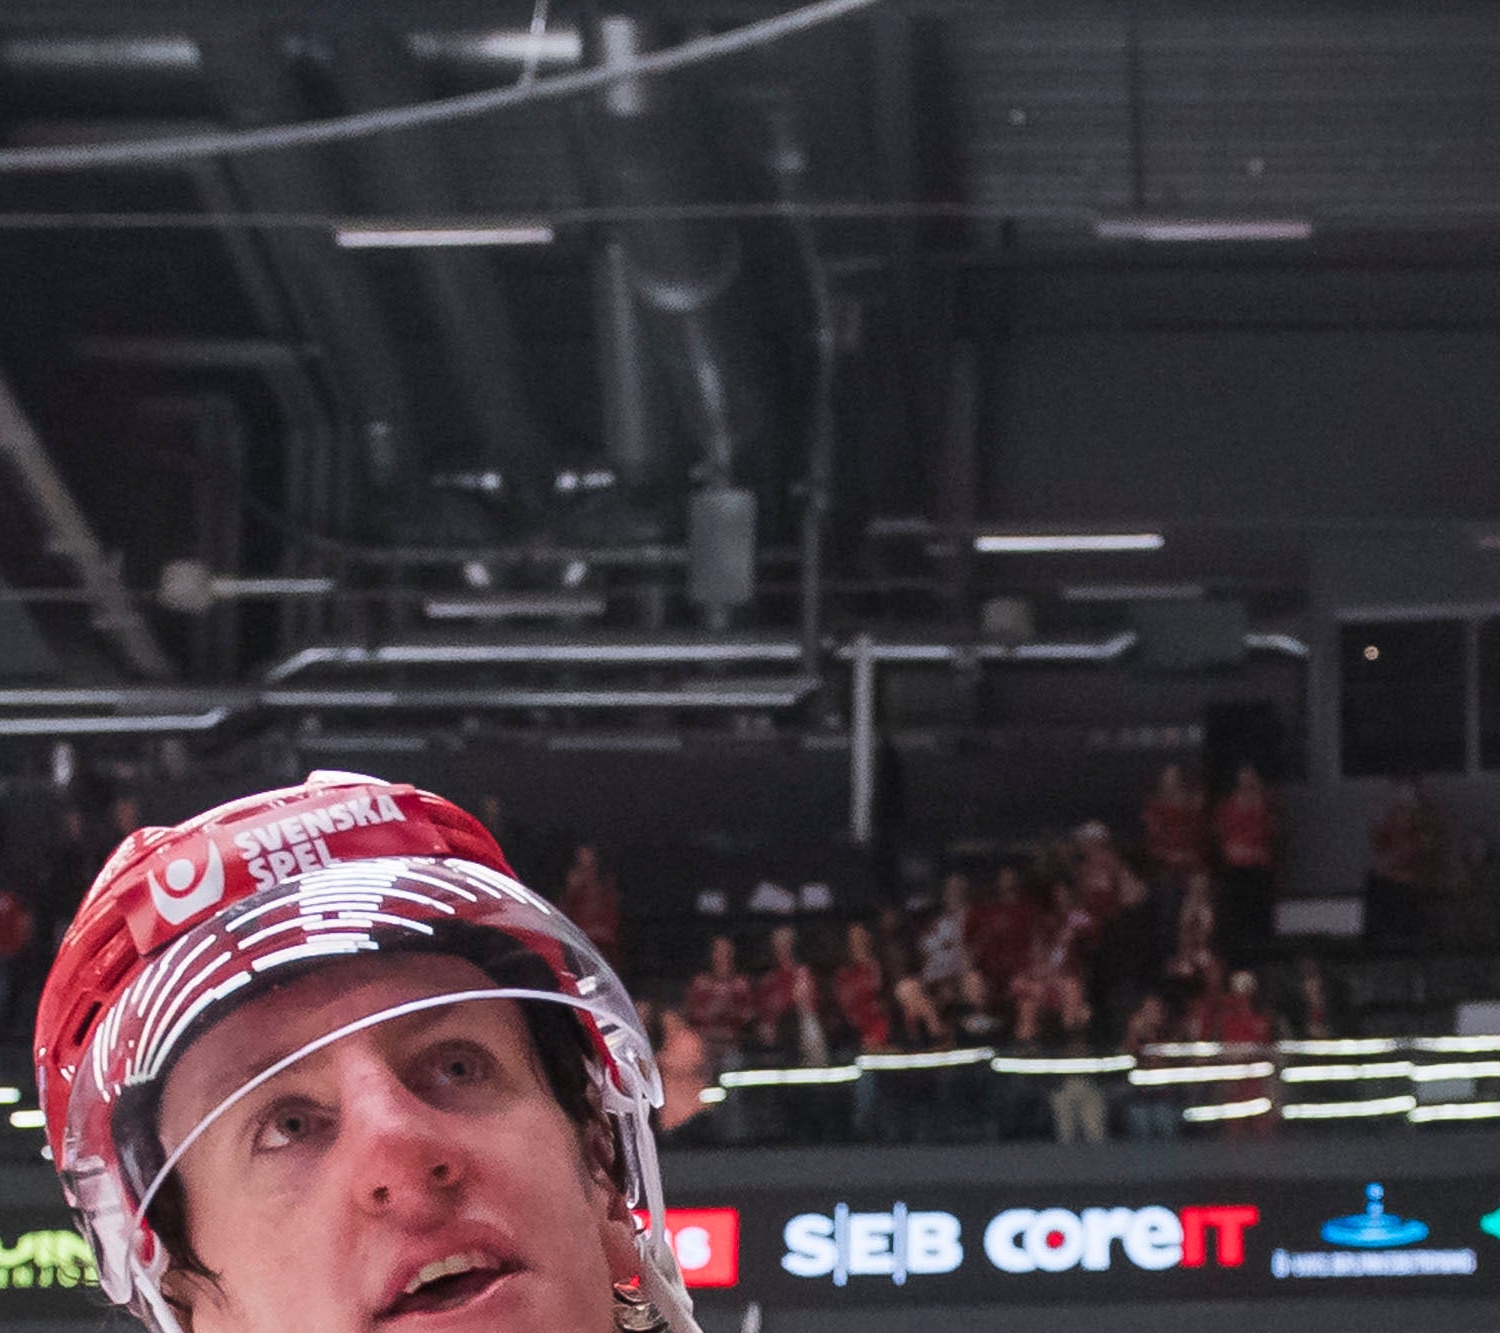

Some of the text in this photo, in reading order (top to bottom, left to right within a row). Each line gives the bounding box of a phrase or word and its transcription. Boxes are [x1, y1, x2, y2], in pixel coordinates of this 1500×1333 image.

[233, 793, 406, 862] SVENSKA
[246, 842, 344, 892] SPEL
[780, 1200, 965, 1287] SEB
